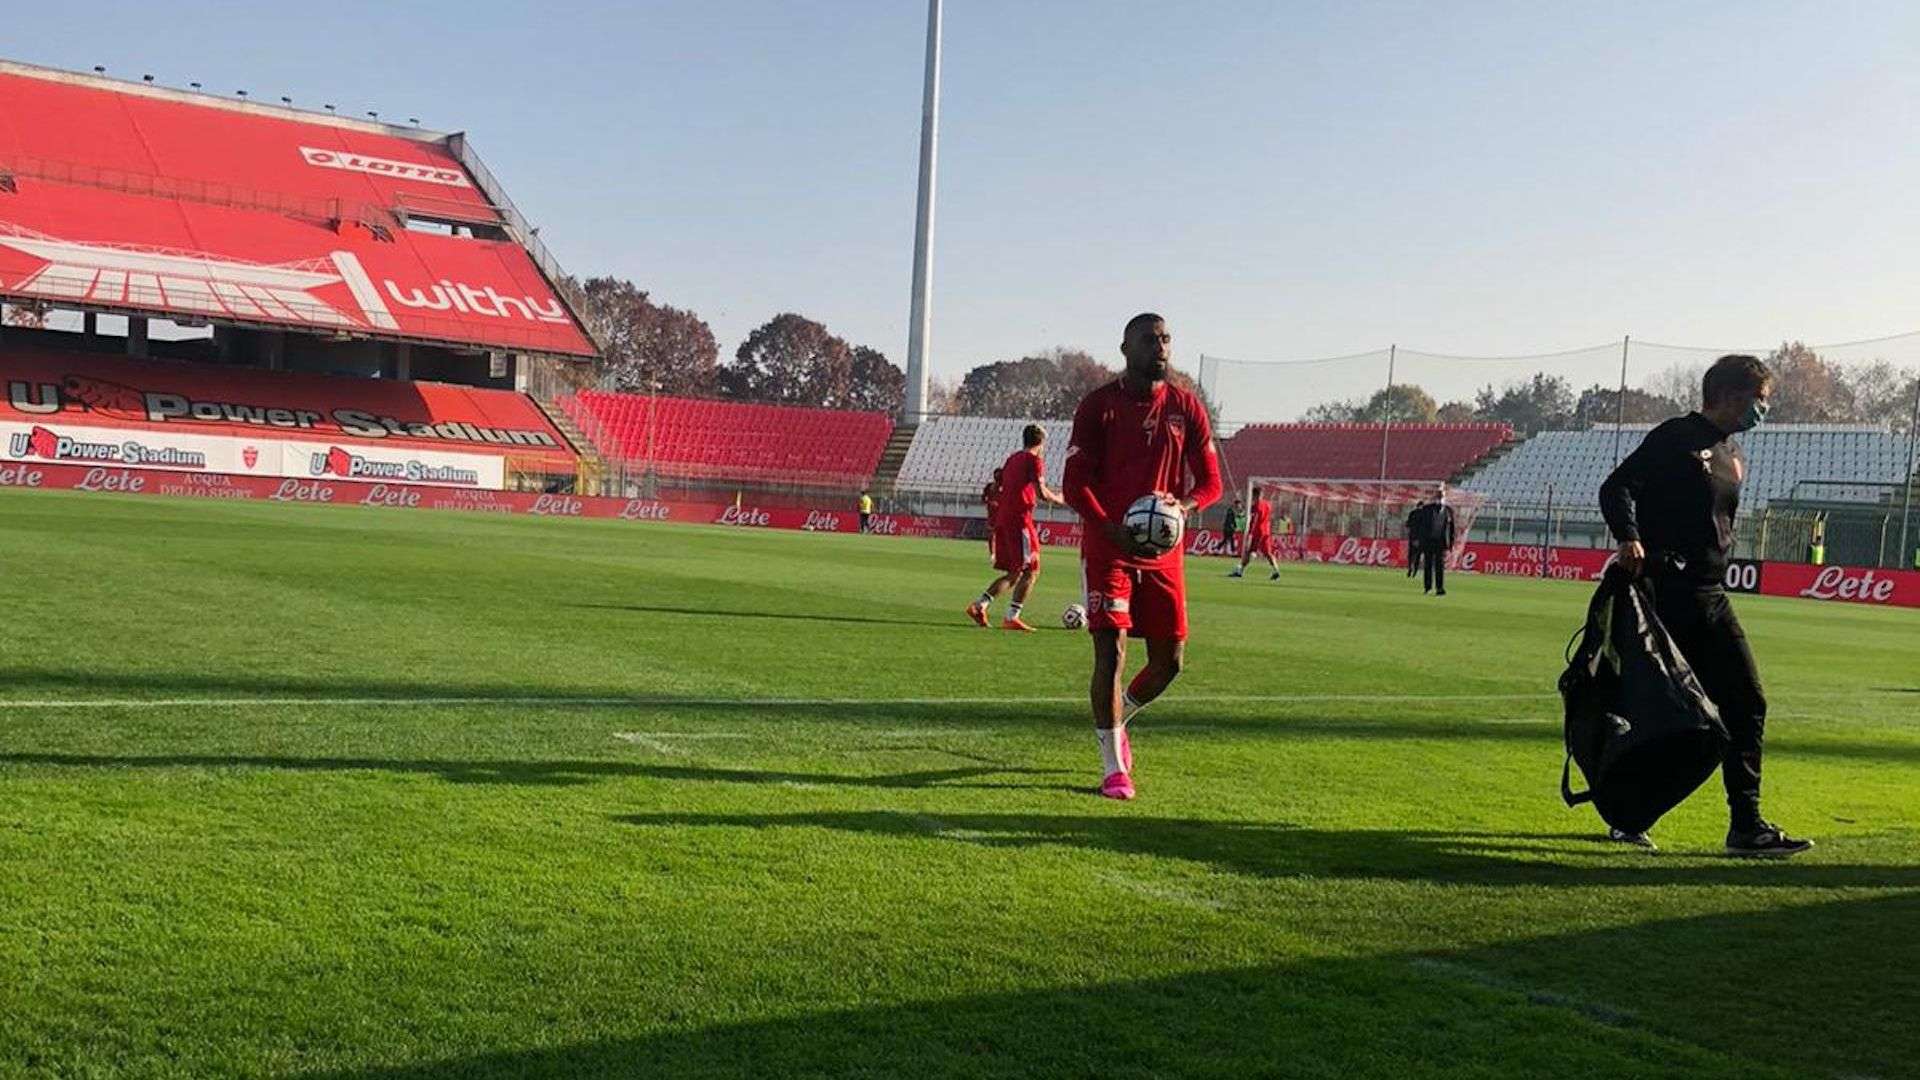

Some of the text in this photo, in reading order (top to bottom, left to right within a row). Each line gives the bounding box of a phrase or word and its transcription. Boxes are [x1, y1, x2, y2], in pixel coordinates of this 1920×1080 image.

[348, 158, 460, 182] LOTTO
[383, 279, 571, 325] withy
[8, 380, 561, 447] U Power Stadium
[9, 432, 206, 468] U Power Stadium
[0, 465, 43, 486] ete
[74, 467, 145, 491] Lete
[310, 452, 478, 485] U Power Stadium
[269, 479, 333, 502] Lete
[360, 483, 421, 507] Lete
[528, 493, 583, 515] Lete
[619, 499, 669, 520] Lete
[715, 504, 770, 526] Lete
[802, 509, 839, 531] Lete
[1186, 529, 1236, 556] Le
[1328, 537, 1391, 564] Lete
[1508, 546, 1559, 562] ACQUA
[1484, 560, 1532, 577] DELLO
[1535, 564, 1584, 580] SPORT
[1800, 565, 1895, 601] Lete
